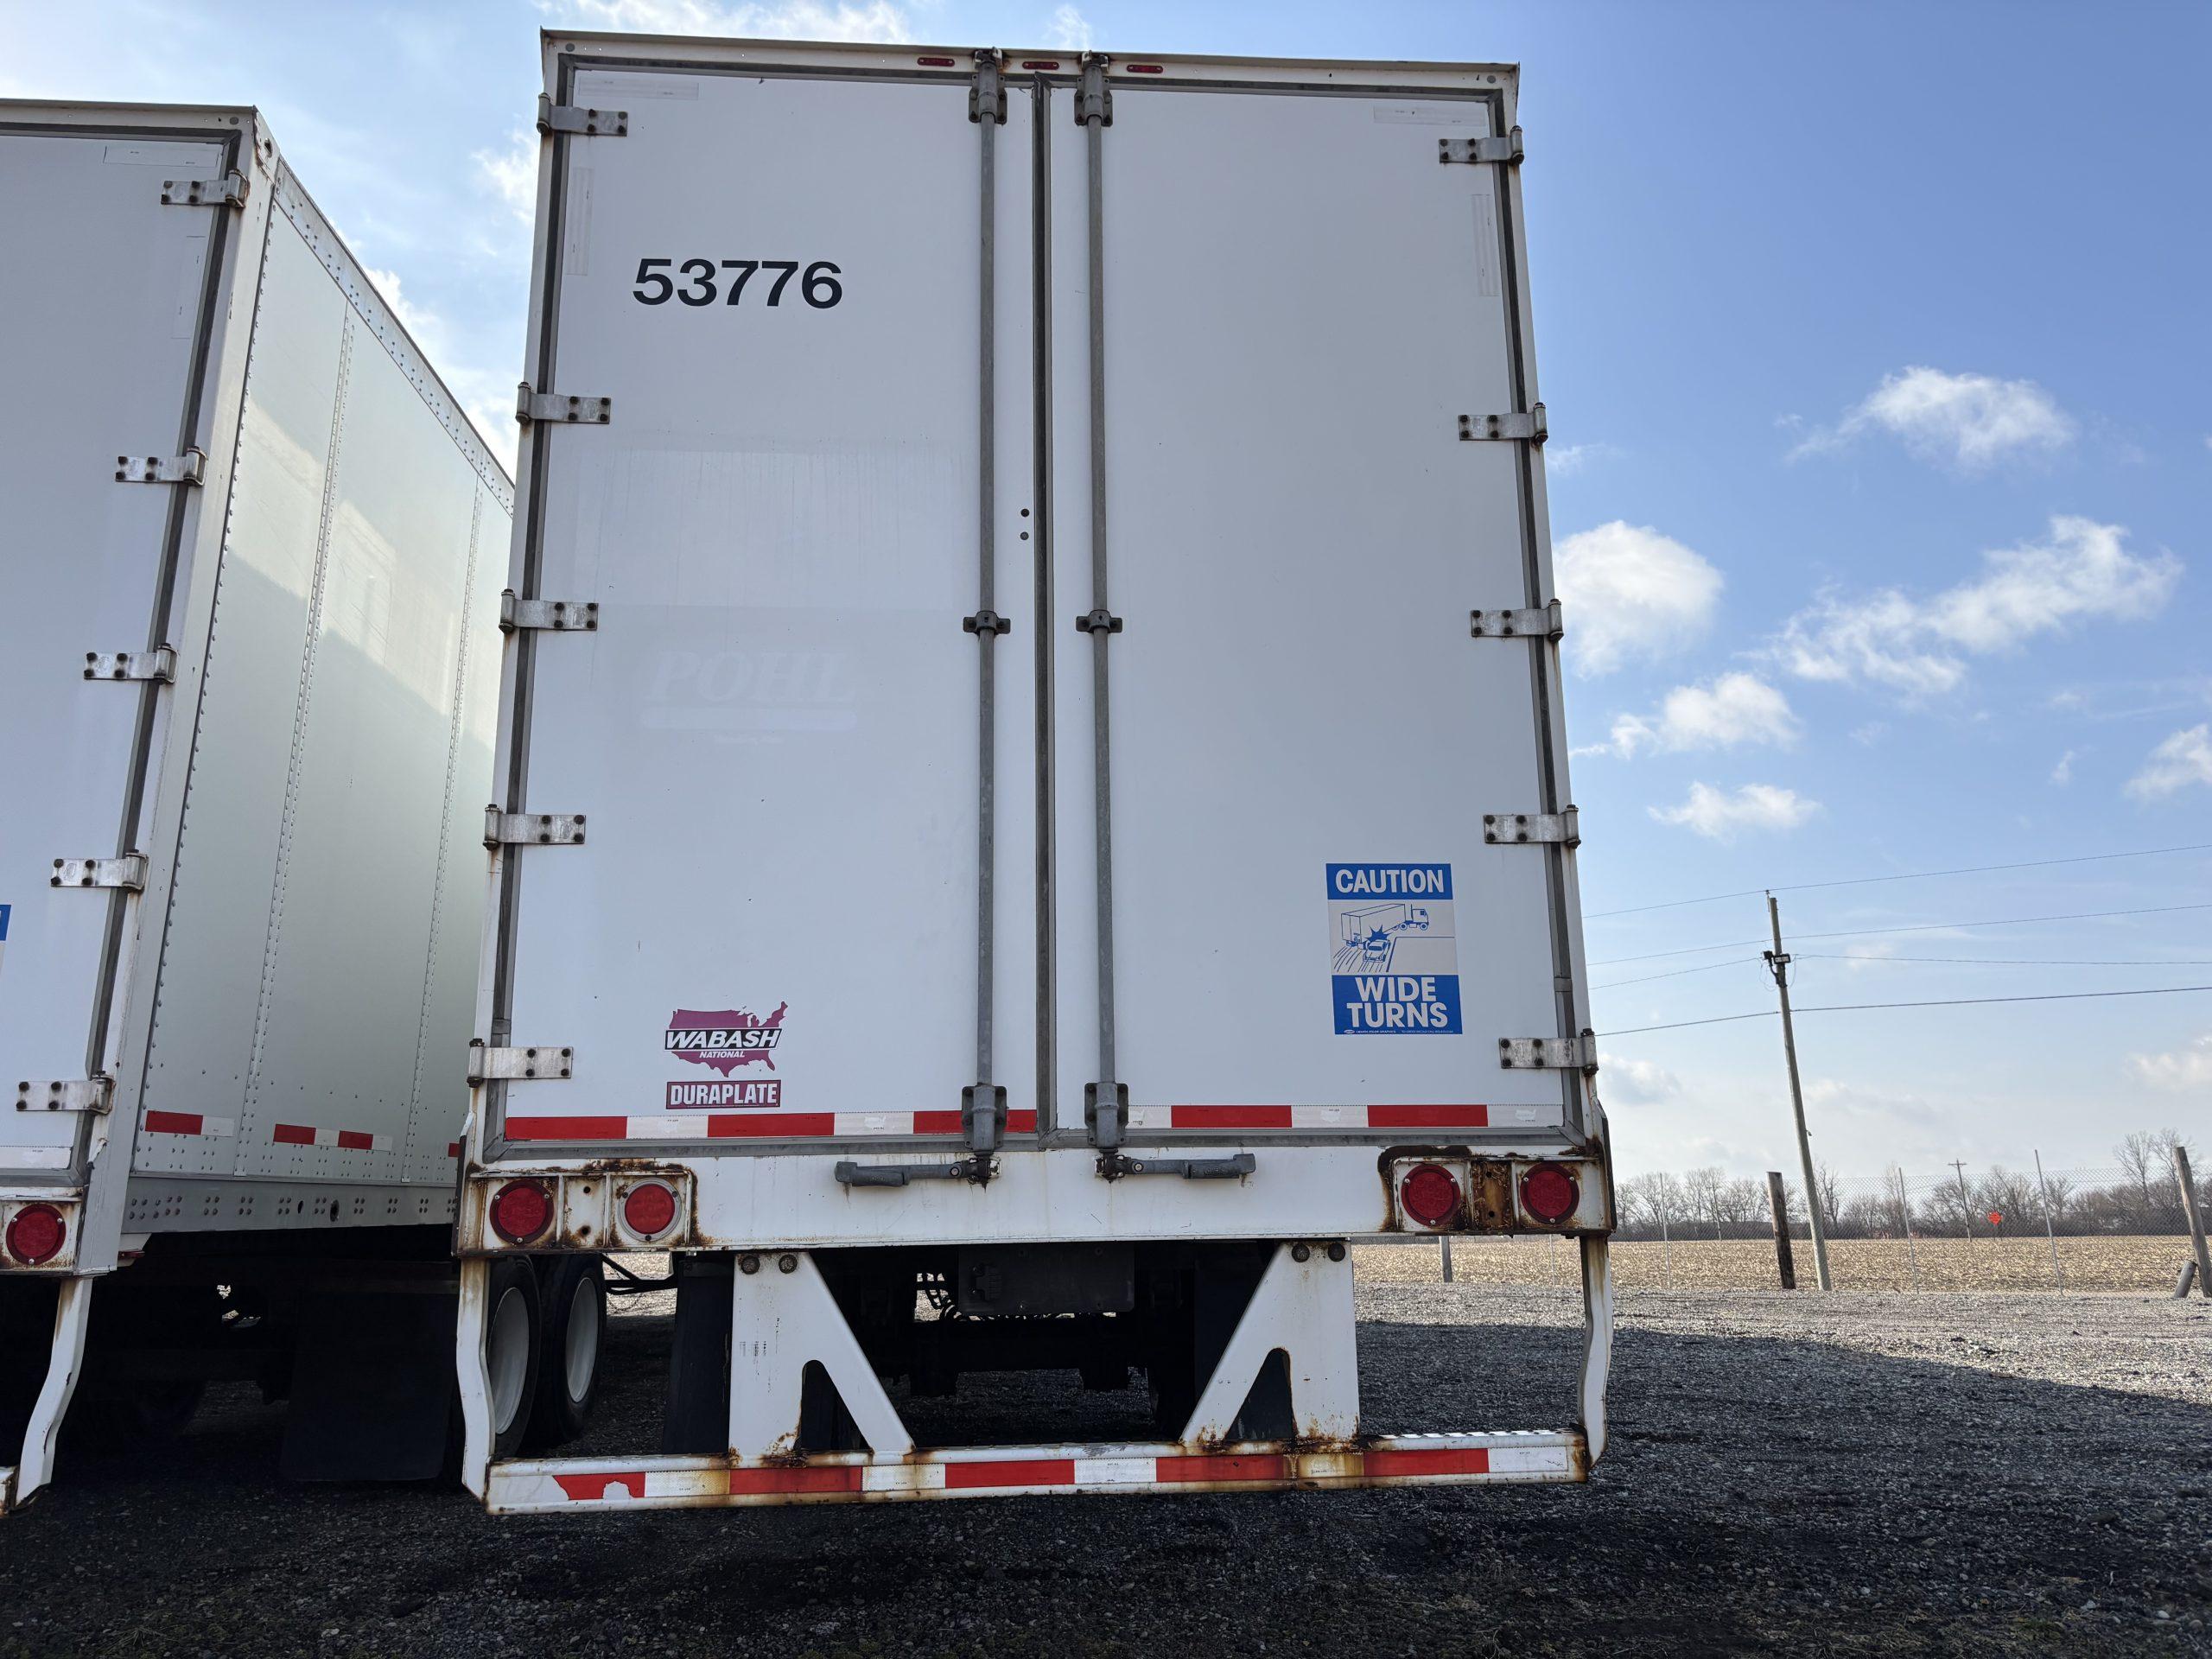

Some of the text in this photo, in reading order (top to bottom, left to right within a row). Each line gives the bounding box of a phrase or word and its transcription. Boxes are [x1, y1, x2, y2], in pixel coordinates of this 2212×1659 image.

[632, 258, 843, 308] 53776
[1335, 868, 1445, 893] CAUTION
[1355, 976, 1437, 1002] WIDE
[1346, 1002, 1448, 1028] TURNS
[667, 1031, 779, 1048] WABASH
[671, 1084, 777, 1105] DURAPLATE
